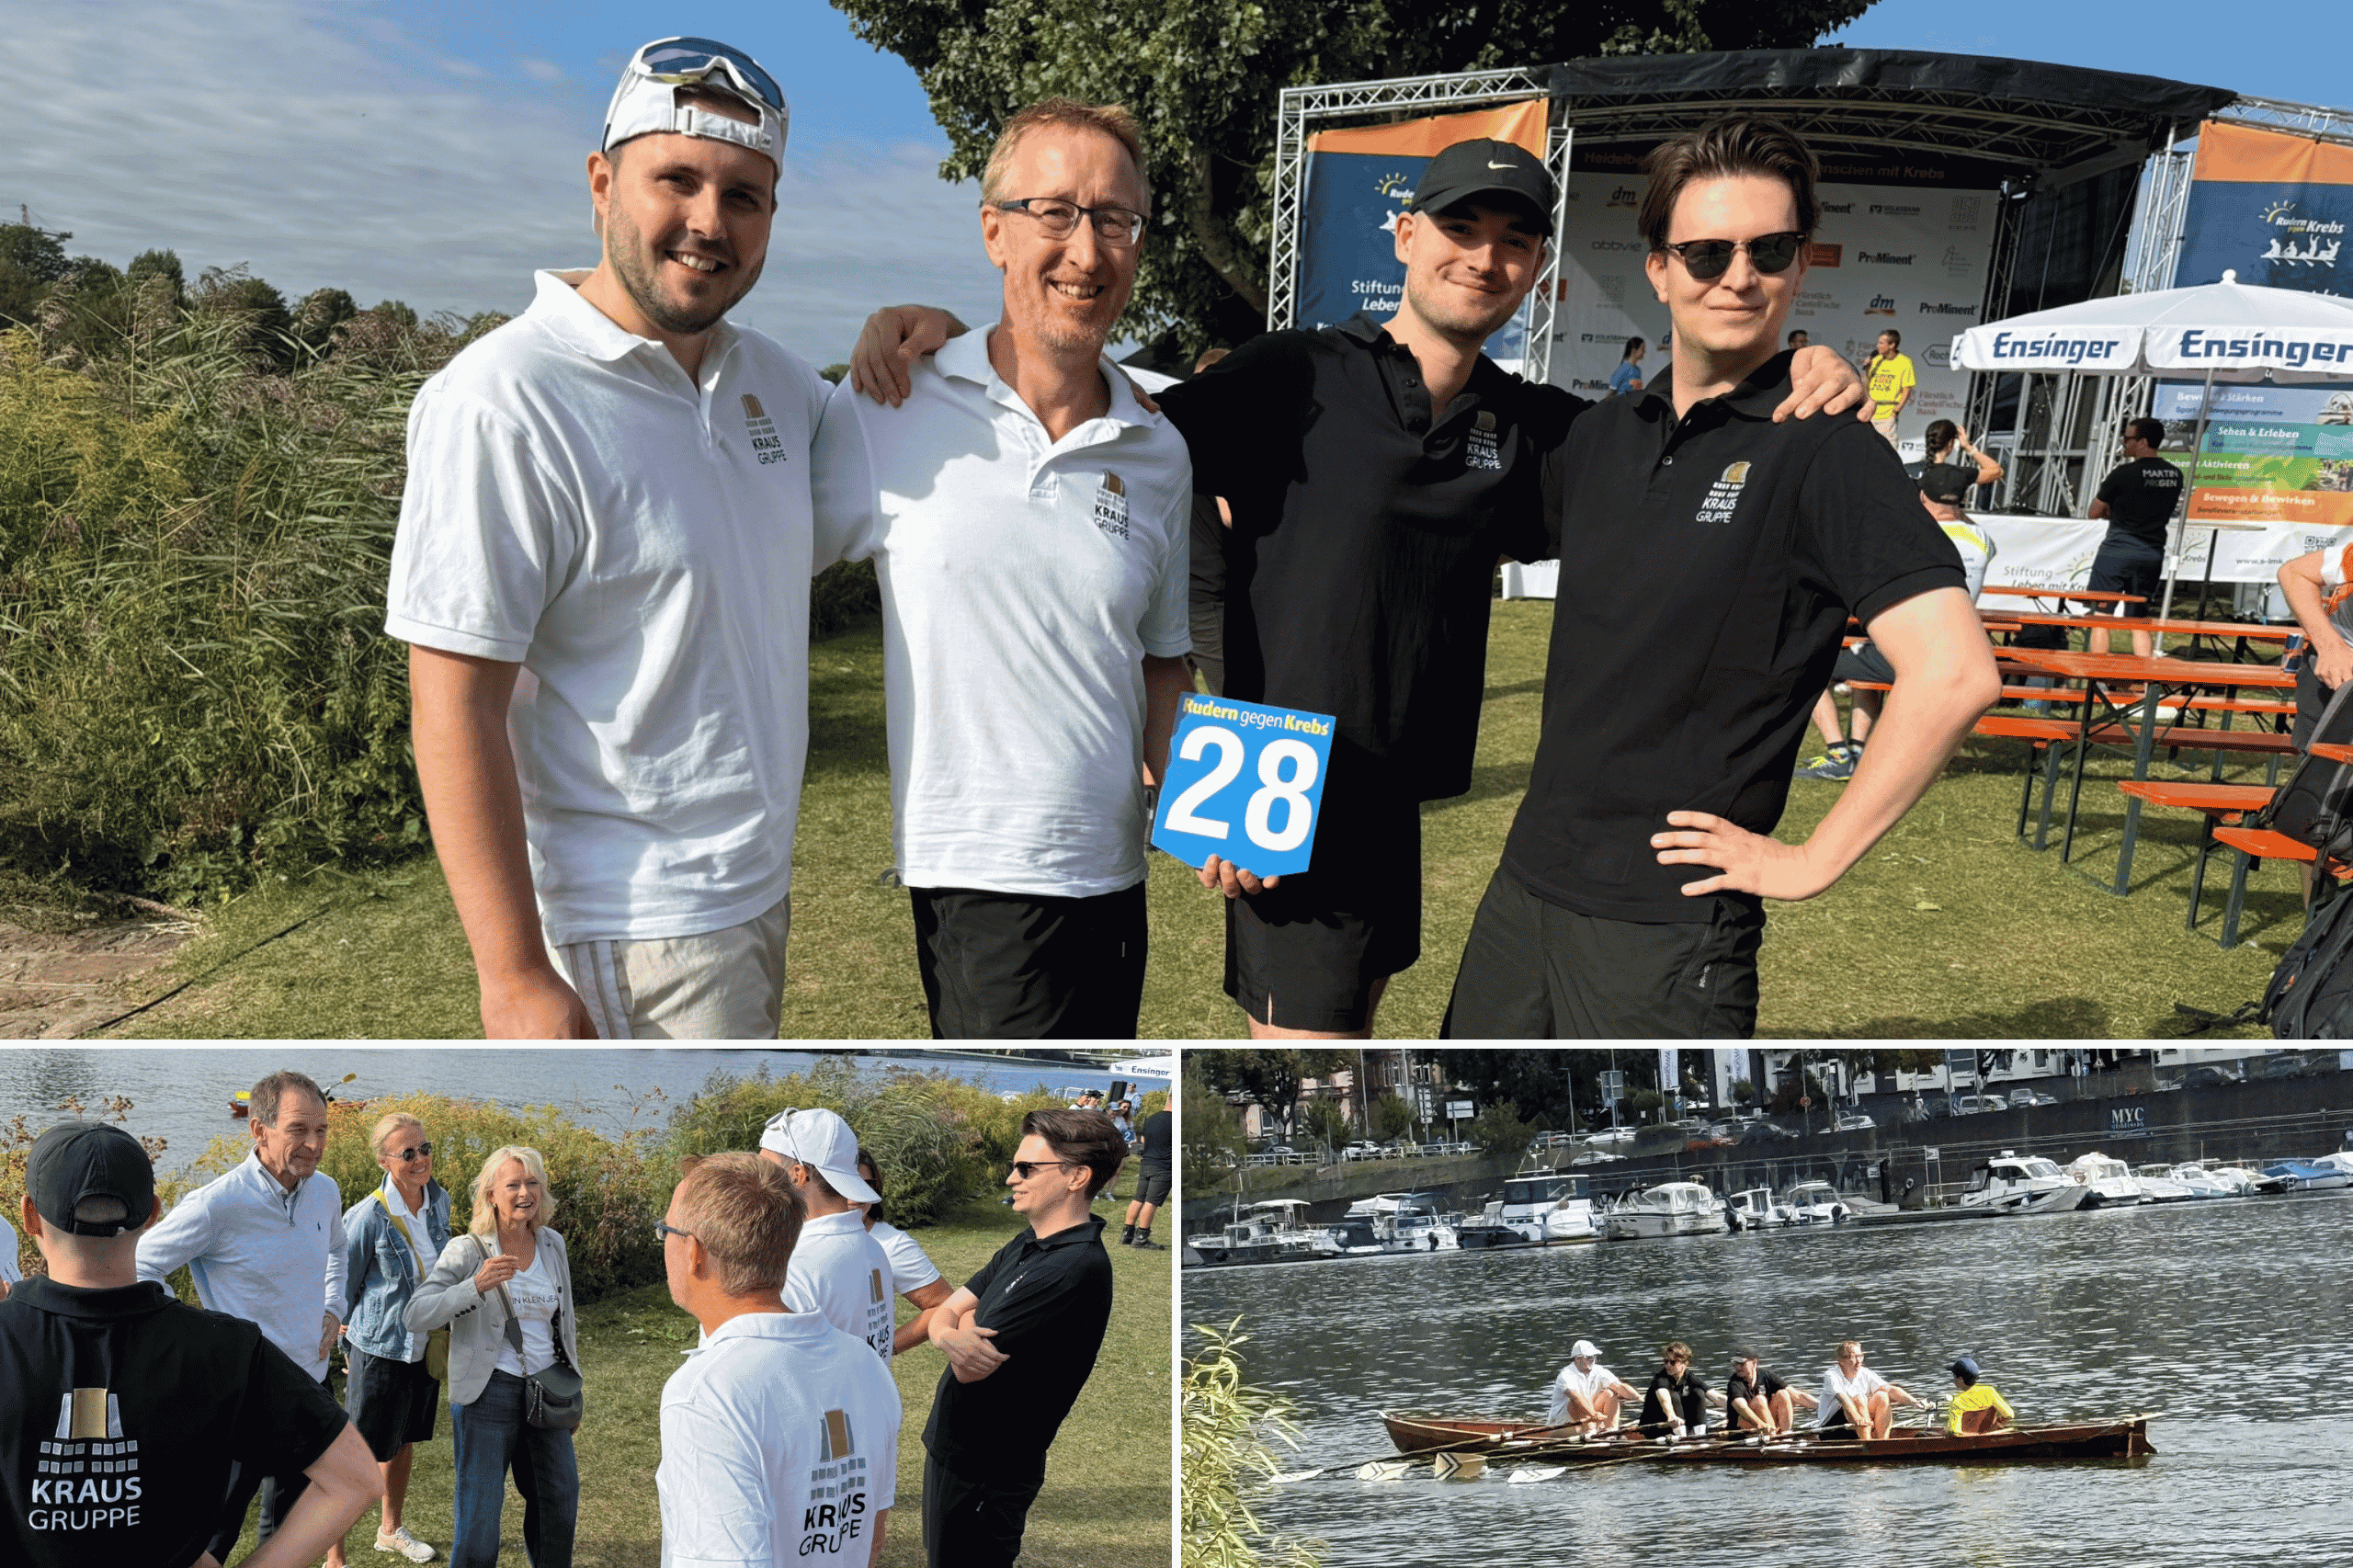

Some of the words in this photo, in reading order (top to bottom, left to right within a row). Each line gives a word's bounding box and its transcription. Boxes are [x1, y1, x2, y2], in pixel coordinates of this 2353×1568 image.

[1878, 165, 1900, 178] mit
[1904, 165, 1945, 179] Krebs
[2275, 216, 2308, 226] Rudern
[2305, 220, 2346, 233] Krebs
[1870, 293, 1895, 309] dm
[1994, 332, 2120, 364] Ensinger
[2179, 329, 2353, 368] Ensinger
[1466, 443, 1498, 459] KRAUS
[1465, 455, 1503, 470] GRUPPE
[2142, 469, 2178, 478] MARTIN
[1700, 496, 1738, 510] KRAUS
[2203, 493, 2247, 505] Bewegen
[2261, 495, 2315, 506] Bewirken
[1095, 505, 1130, 528] KRAUS
[1695, 511, 1733, 523] GRUPPE
[1094, 517, 1131, 540] GRUPPE
[2003, 565, 2053, 580] Stiftung
[1183, 698, 1239, 721] Rudern
[1240, 710, 1283, 730] gegen
[1283, 714, 1331, 736] Krebs
[1164, 725, 1319, 852] 28
[1131, 1065, 1170, 1076] Ensinger
[2111, 1107, 2144, 1123] MYC
[522, 1295, 546, 1304] KLEIN
[31, 1476, 142, 1505] KRAUS
[28, 1505, 141, 1530] GRUPPE
[803, 1493, 866, 1532] KRUS
